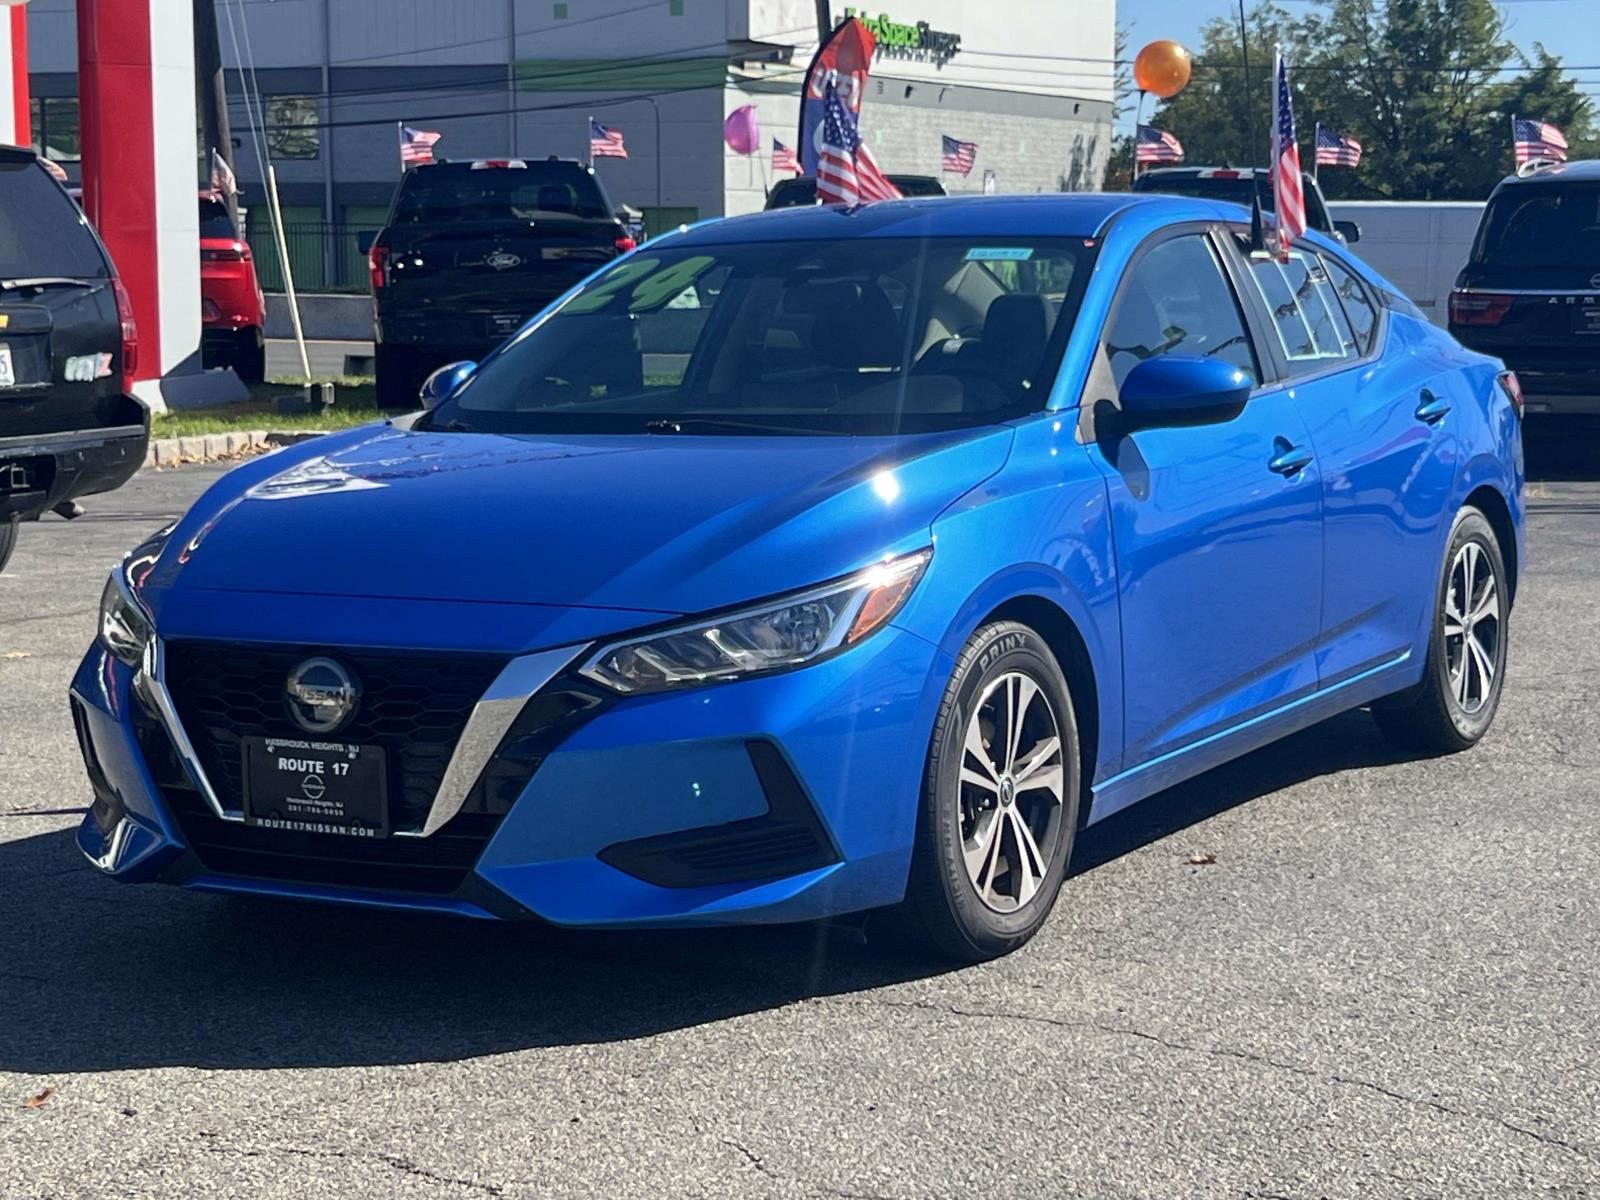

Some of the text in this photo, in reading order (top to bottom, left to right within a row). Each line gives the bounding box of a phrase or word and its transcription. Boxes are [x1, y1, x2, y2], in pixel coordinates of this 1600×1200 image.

[278, 757, 350, 776] ROUTE 17
[257, 818, 375, 837] ROUTE17NISSAN.COM
